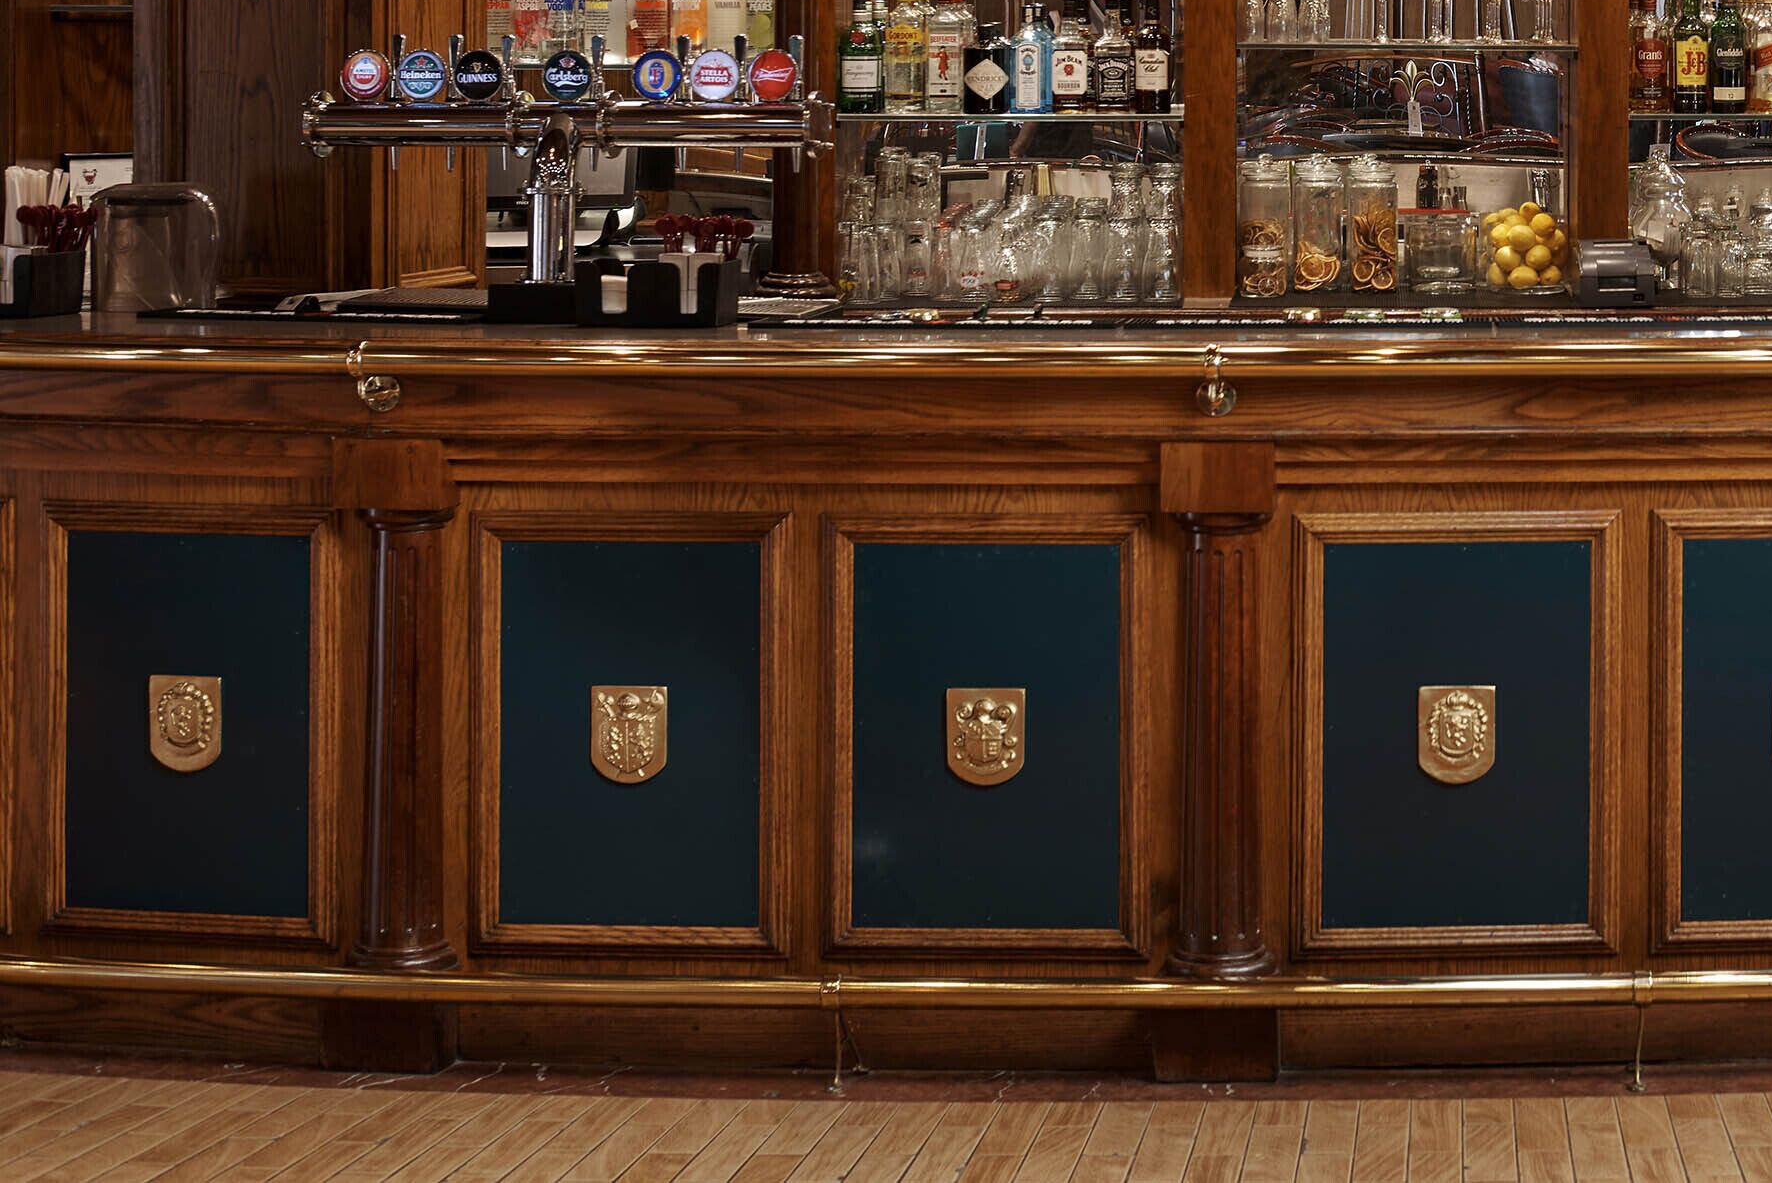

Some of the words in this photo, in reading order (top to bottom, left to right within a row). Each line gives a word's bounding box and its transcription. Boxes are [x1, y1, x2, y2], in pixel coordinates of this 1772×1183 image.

[400, 70, 442, 79] Heineken
[457, 72, 498, 83] GUINNESS
[546, 67, 588, 84] Carlsberg
